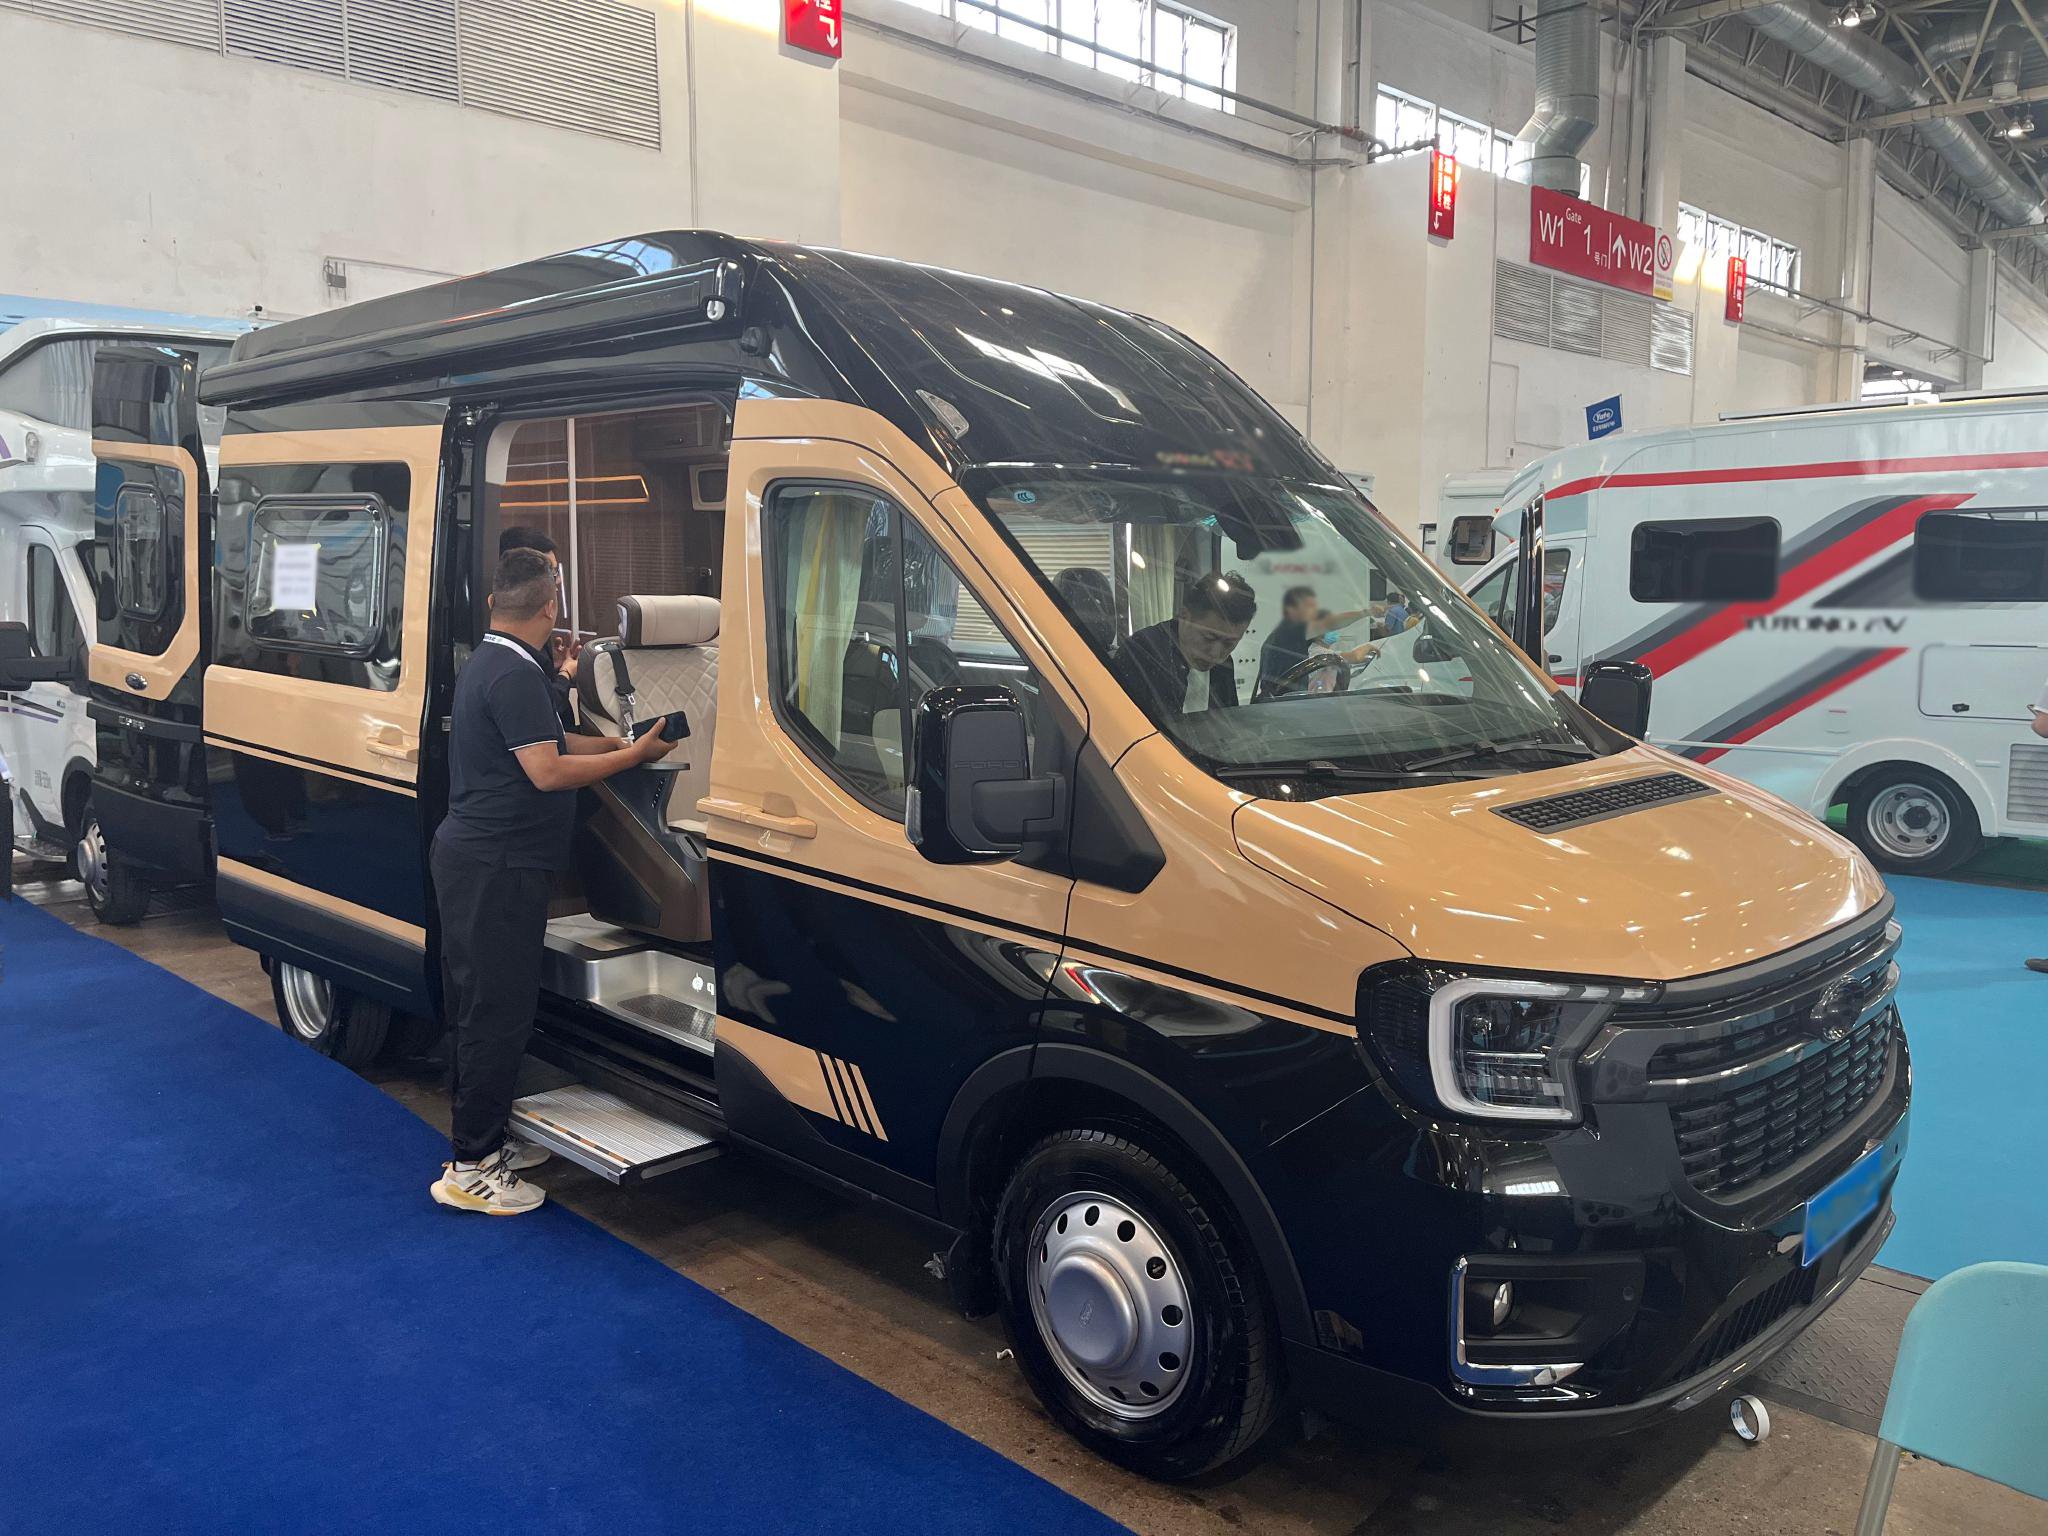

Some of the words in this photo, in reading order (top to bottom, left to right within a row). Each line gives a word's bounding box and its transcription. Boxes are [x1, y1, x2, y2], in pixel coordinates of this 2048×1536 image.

[1539, 210, 1564, 248] W1
[1565, 207, 1582, 225] Gate
[1583, 224, 1591, 256] 1
[1628, 239, 1653, 276] W2
